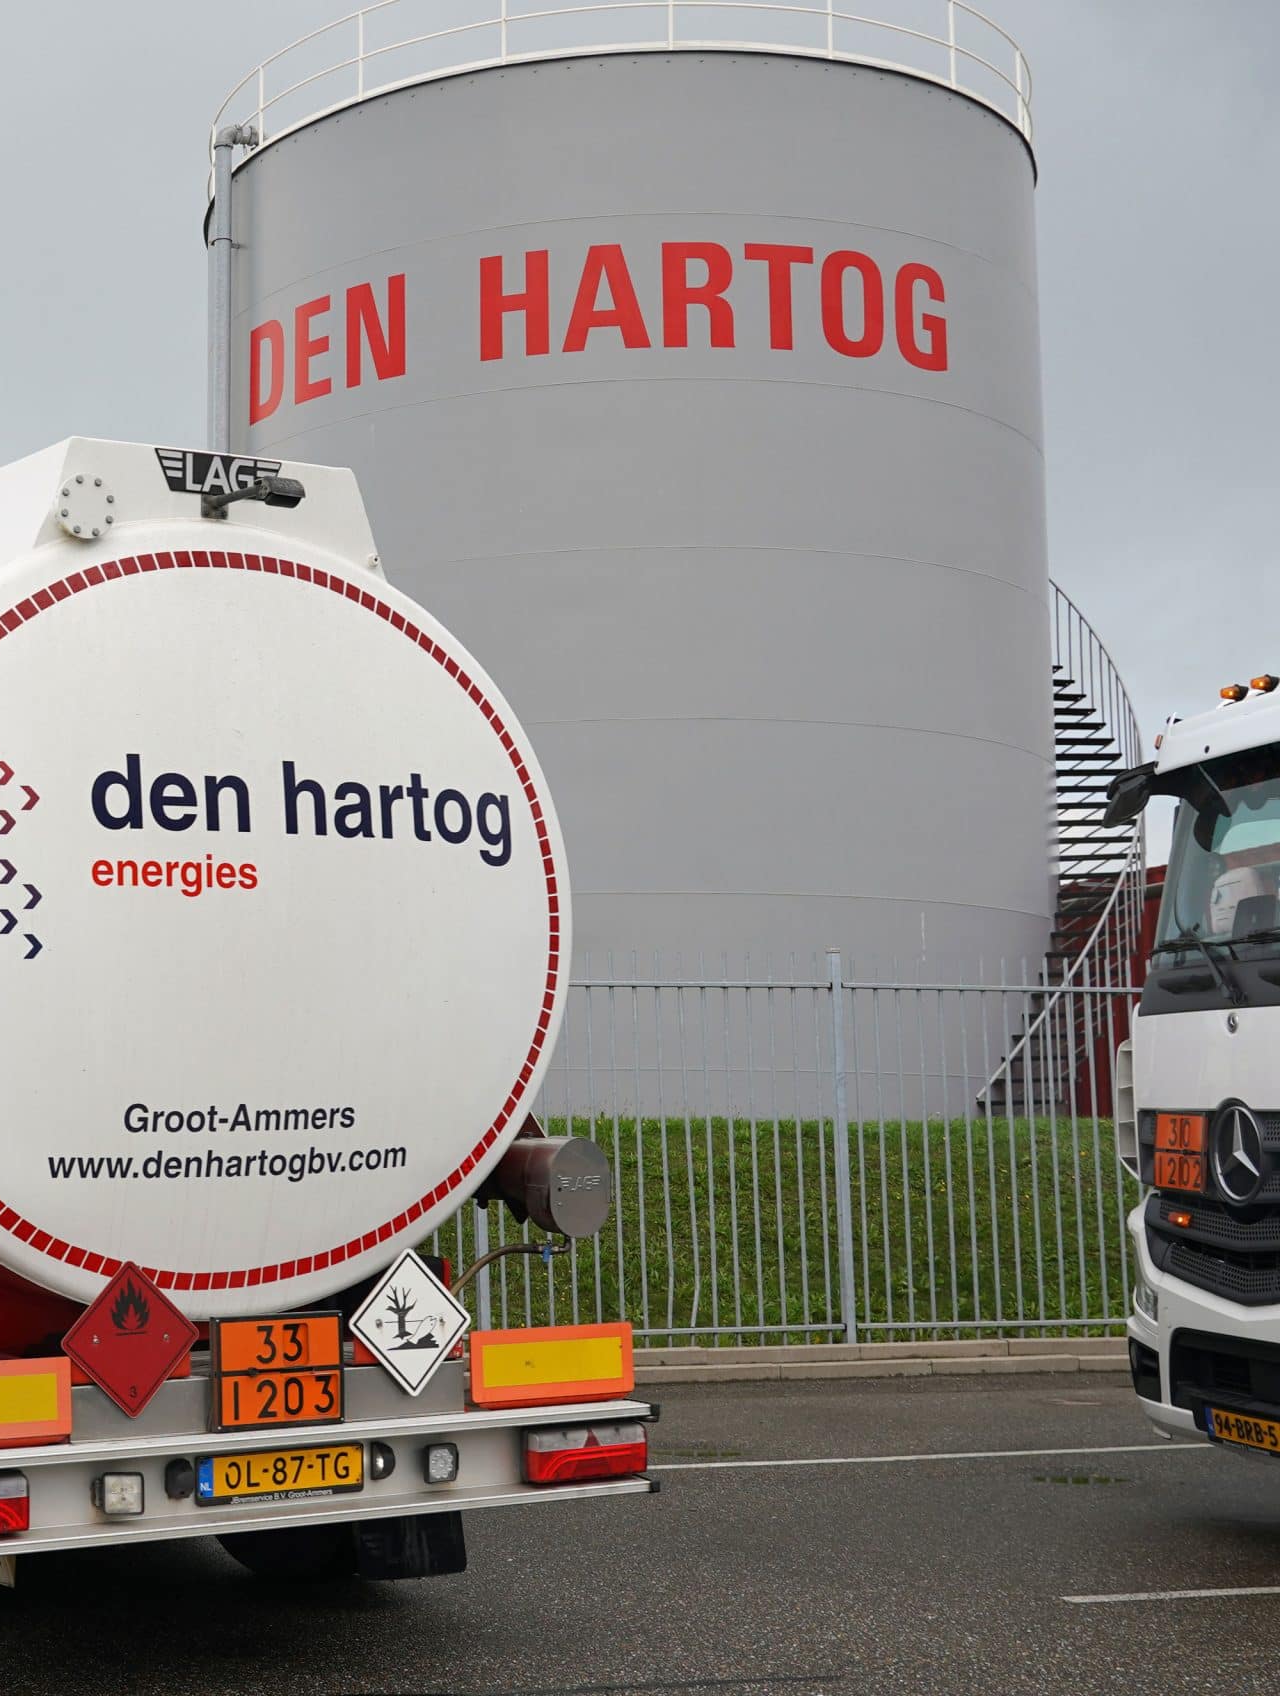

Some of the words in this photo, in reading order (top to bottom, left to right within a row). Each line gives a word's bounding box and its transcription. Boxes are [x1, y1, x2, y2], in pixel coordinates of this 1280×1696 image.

[249, 273, 406, 426] DEN
[480, 242, 948, 371] HARTOG
[186, 453, 255, 495] LAG
[91, 753, 251, 833] den
[282, 760, 512, 867] hartog
[91, 853, 259, 897] energies
[123, 1103, 356, 1133] Groot-Ammers
[1167, 1118, 1192, 1148] 30
[48, 1146, 408, 1183] www.denhartogbv.com
[1158, 1154, 1202, 1188] 1202
[256, 1324, 304, 1364] 33
[128, 1386, 139, 1399] 3
[233, 1375, 335, 1420] 1203
[1215, 1414, 1278, 1447] 94-BRB-5
[225, 1452, 350, 1489] OL-87-TG
